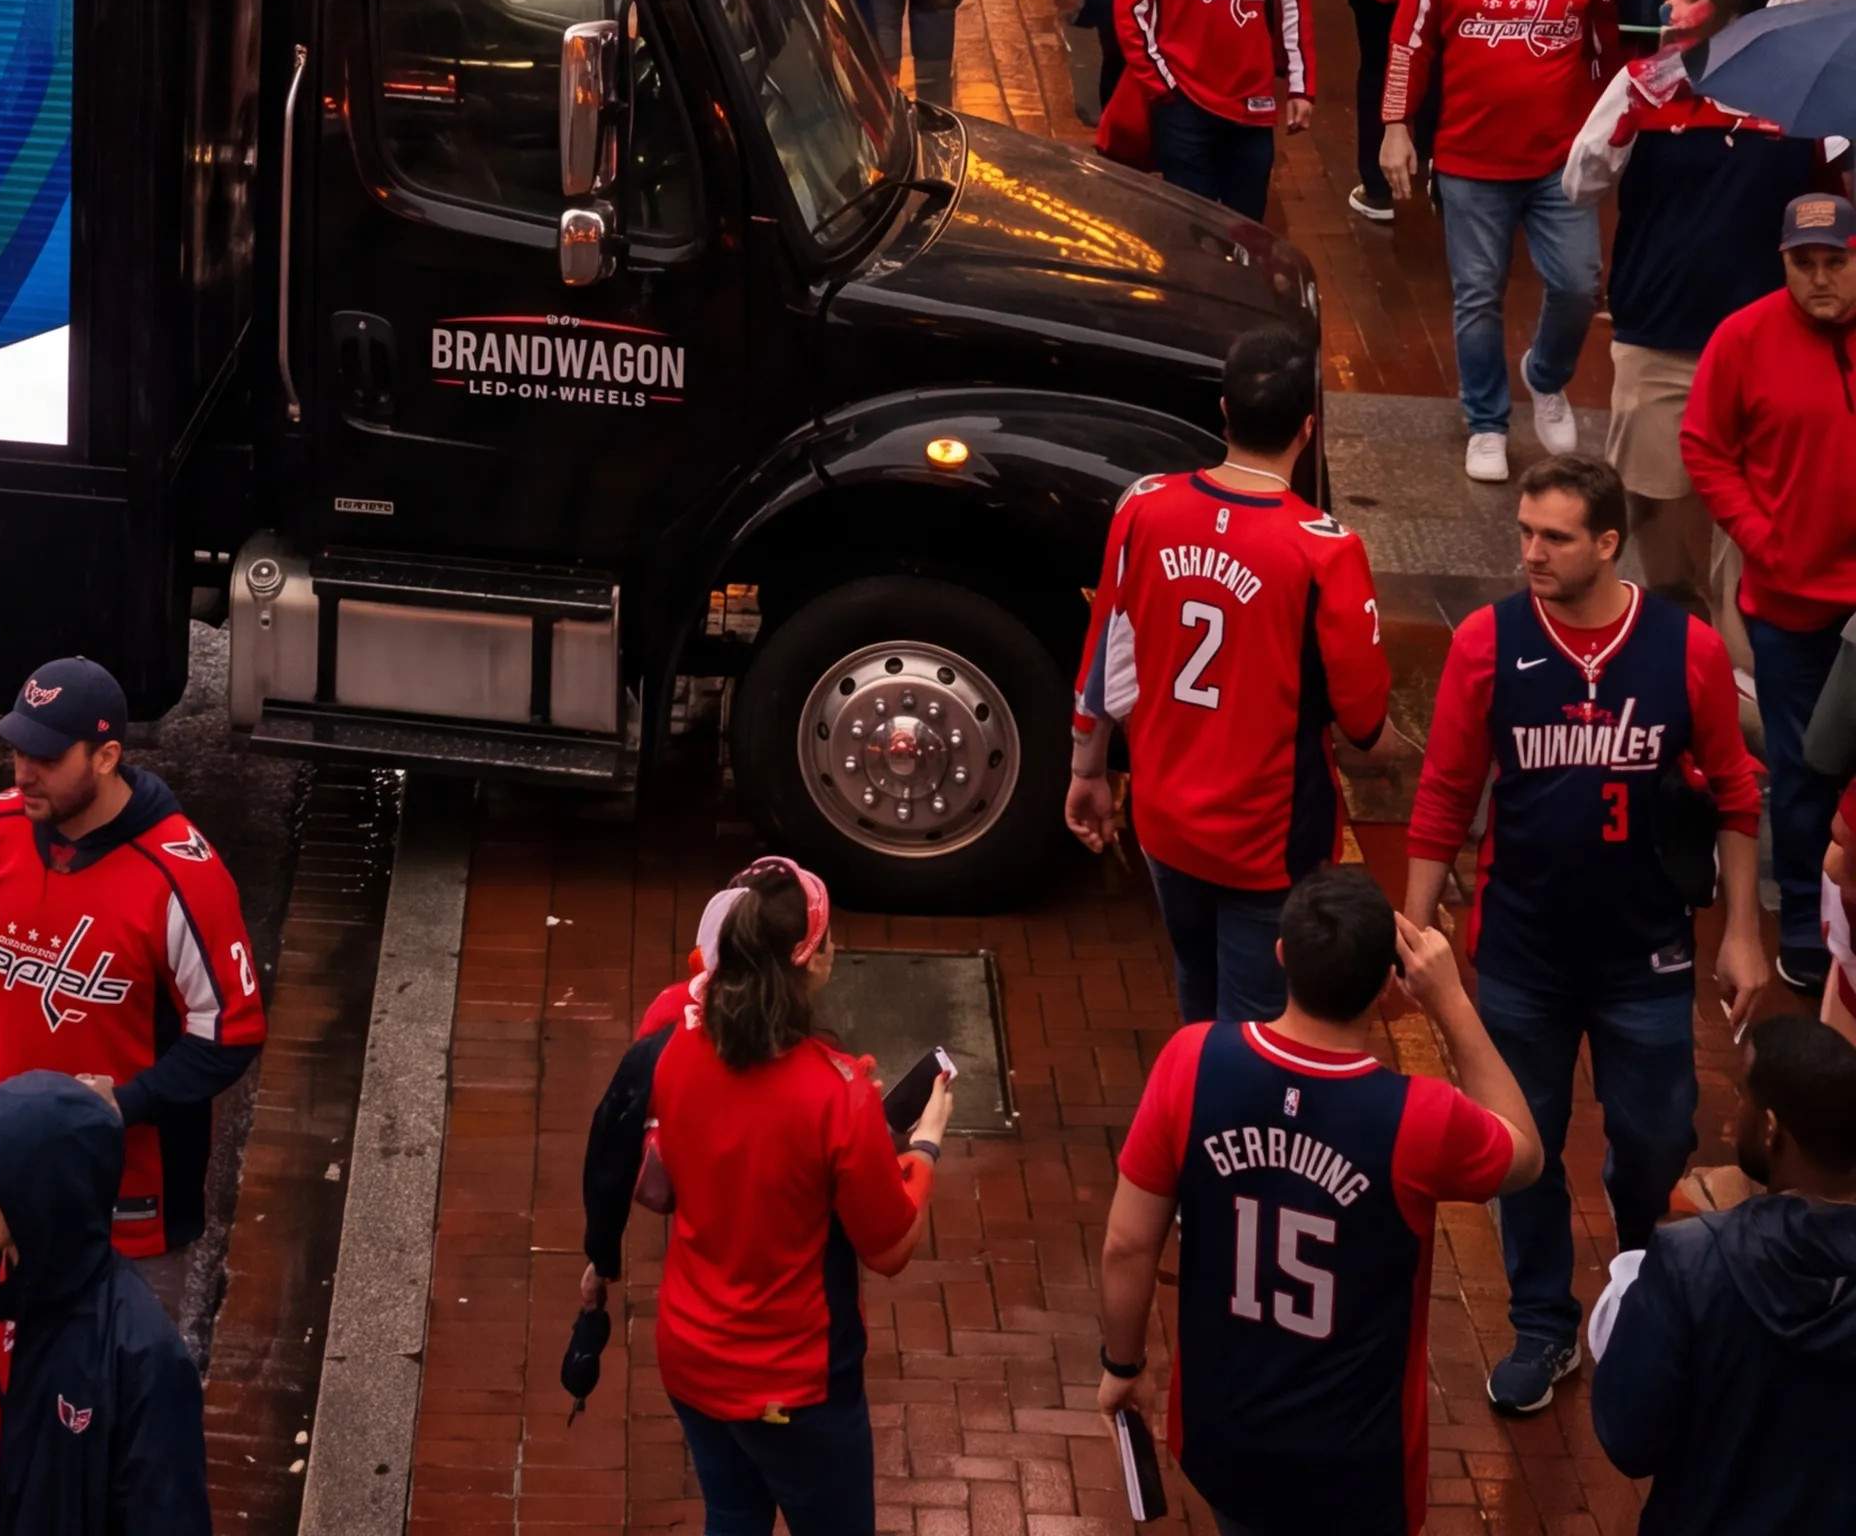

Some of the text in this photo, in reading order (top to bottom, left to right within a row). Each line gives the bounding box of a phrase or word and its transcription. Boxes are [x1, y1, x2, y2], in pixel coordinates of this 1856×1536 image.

[431, 328, 685, 389] BRANDWAGON
[1173, 600, 1225, 709] 2
[1601, 782, 1629, 842] 3
[1231, 1195, 1336, 1339] 15
